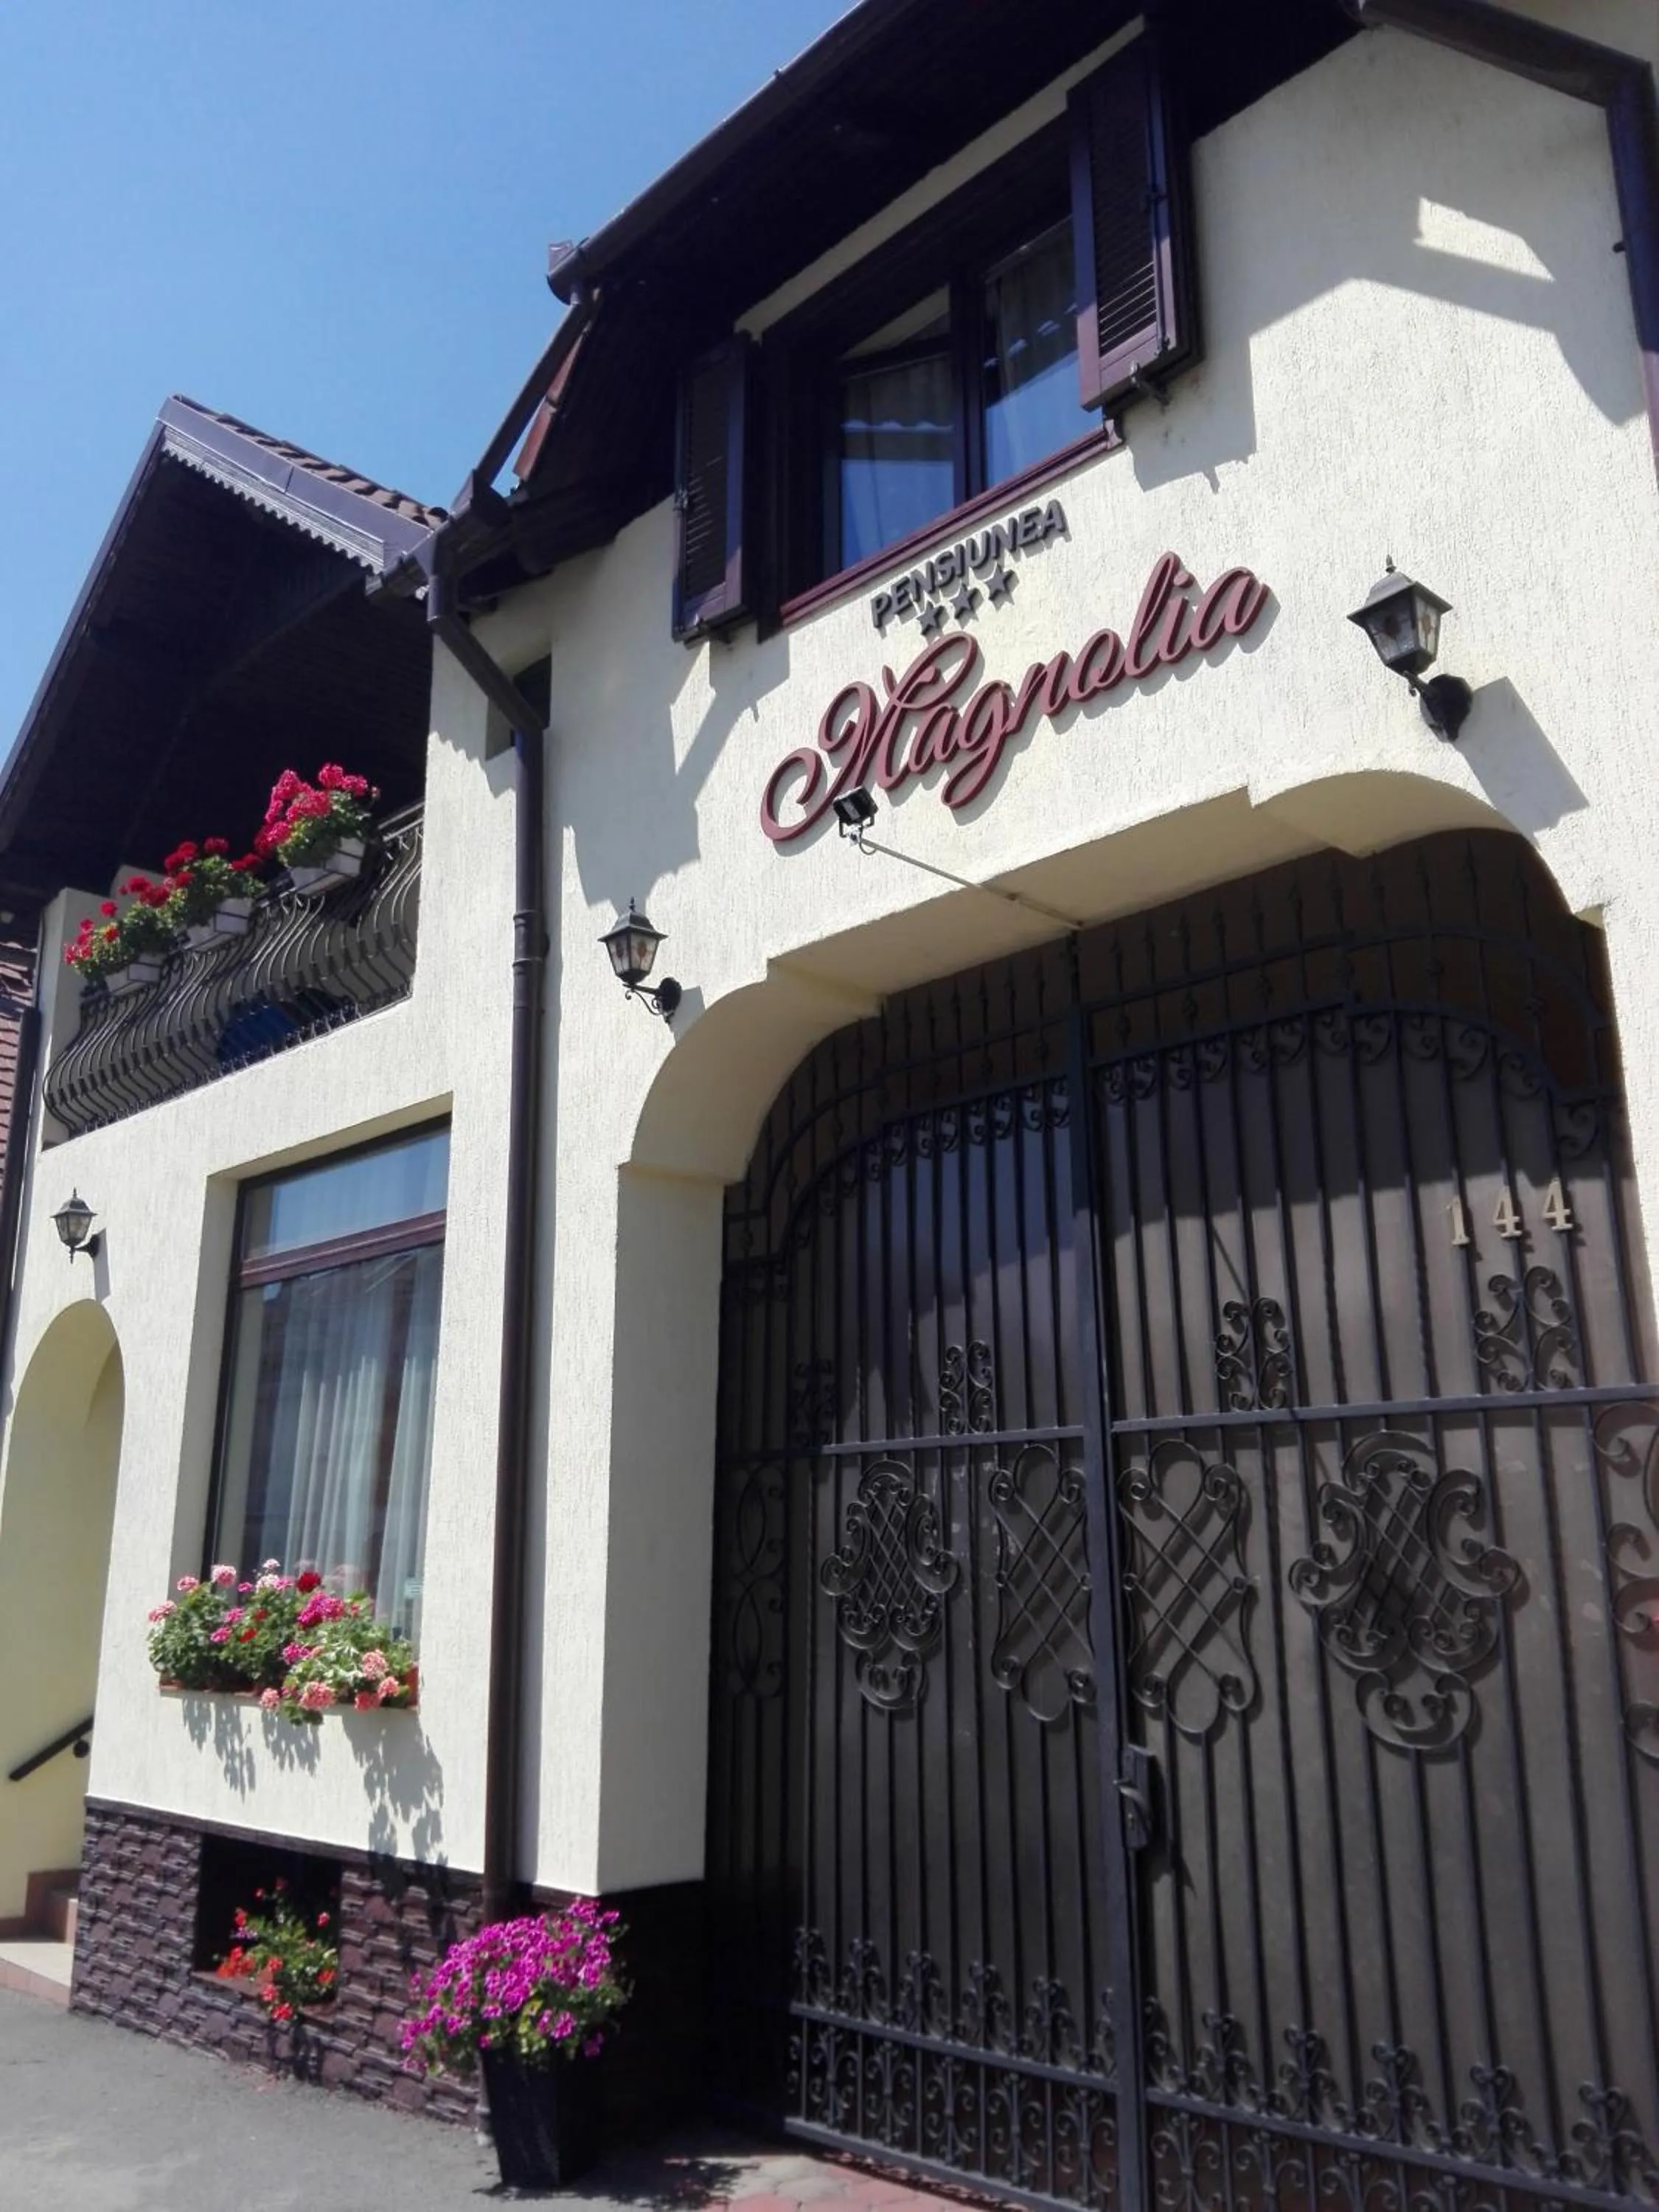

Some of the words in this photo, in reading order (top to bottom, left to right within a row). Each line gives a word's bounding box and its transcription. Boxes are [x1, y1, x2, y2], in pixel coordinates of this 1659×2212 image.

[870, 499, 1067, 628] PENSIUNEA
[760, 551, 1270, 841] Magnolia
[1443, 1178, 1573, 1245] 144
